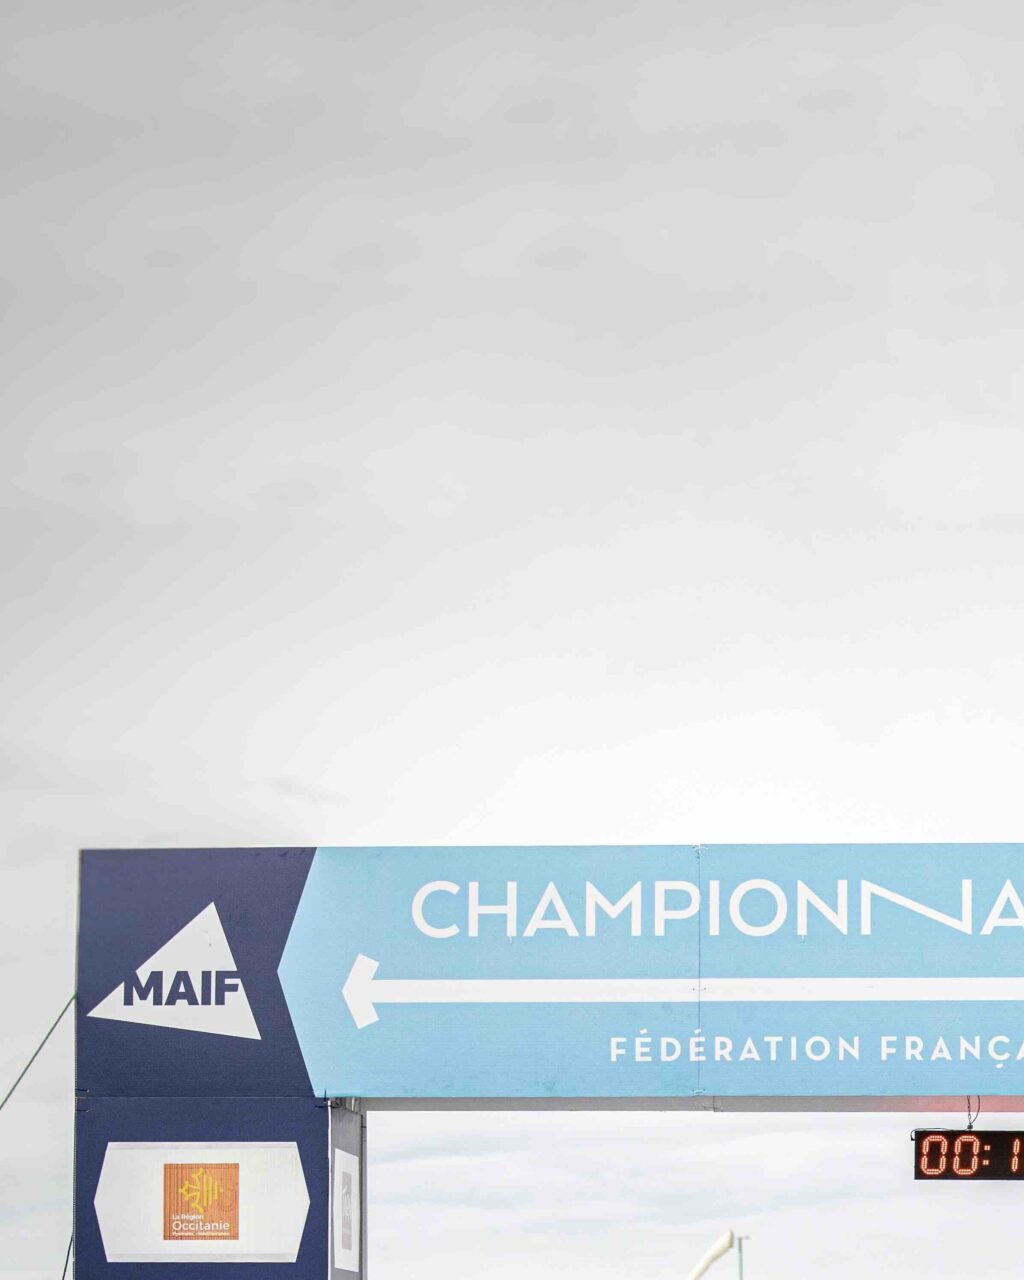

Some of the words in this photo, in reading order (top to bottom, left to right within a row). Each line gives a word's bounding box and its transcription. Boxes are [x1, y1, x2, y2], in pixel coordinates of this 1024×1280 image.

[123, 970, 239, 1006] MAIF
[610, 1028, 860, 1062] FÉDÉRATION
[172, 1220, 230, 1231] Occitanie
